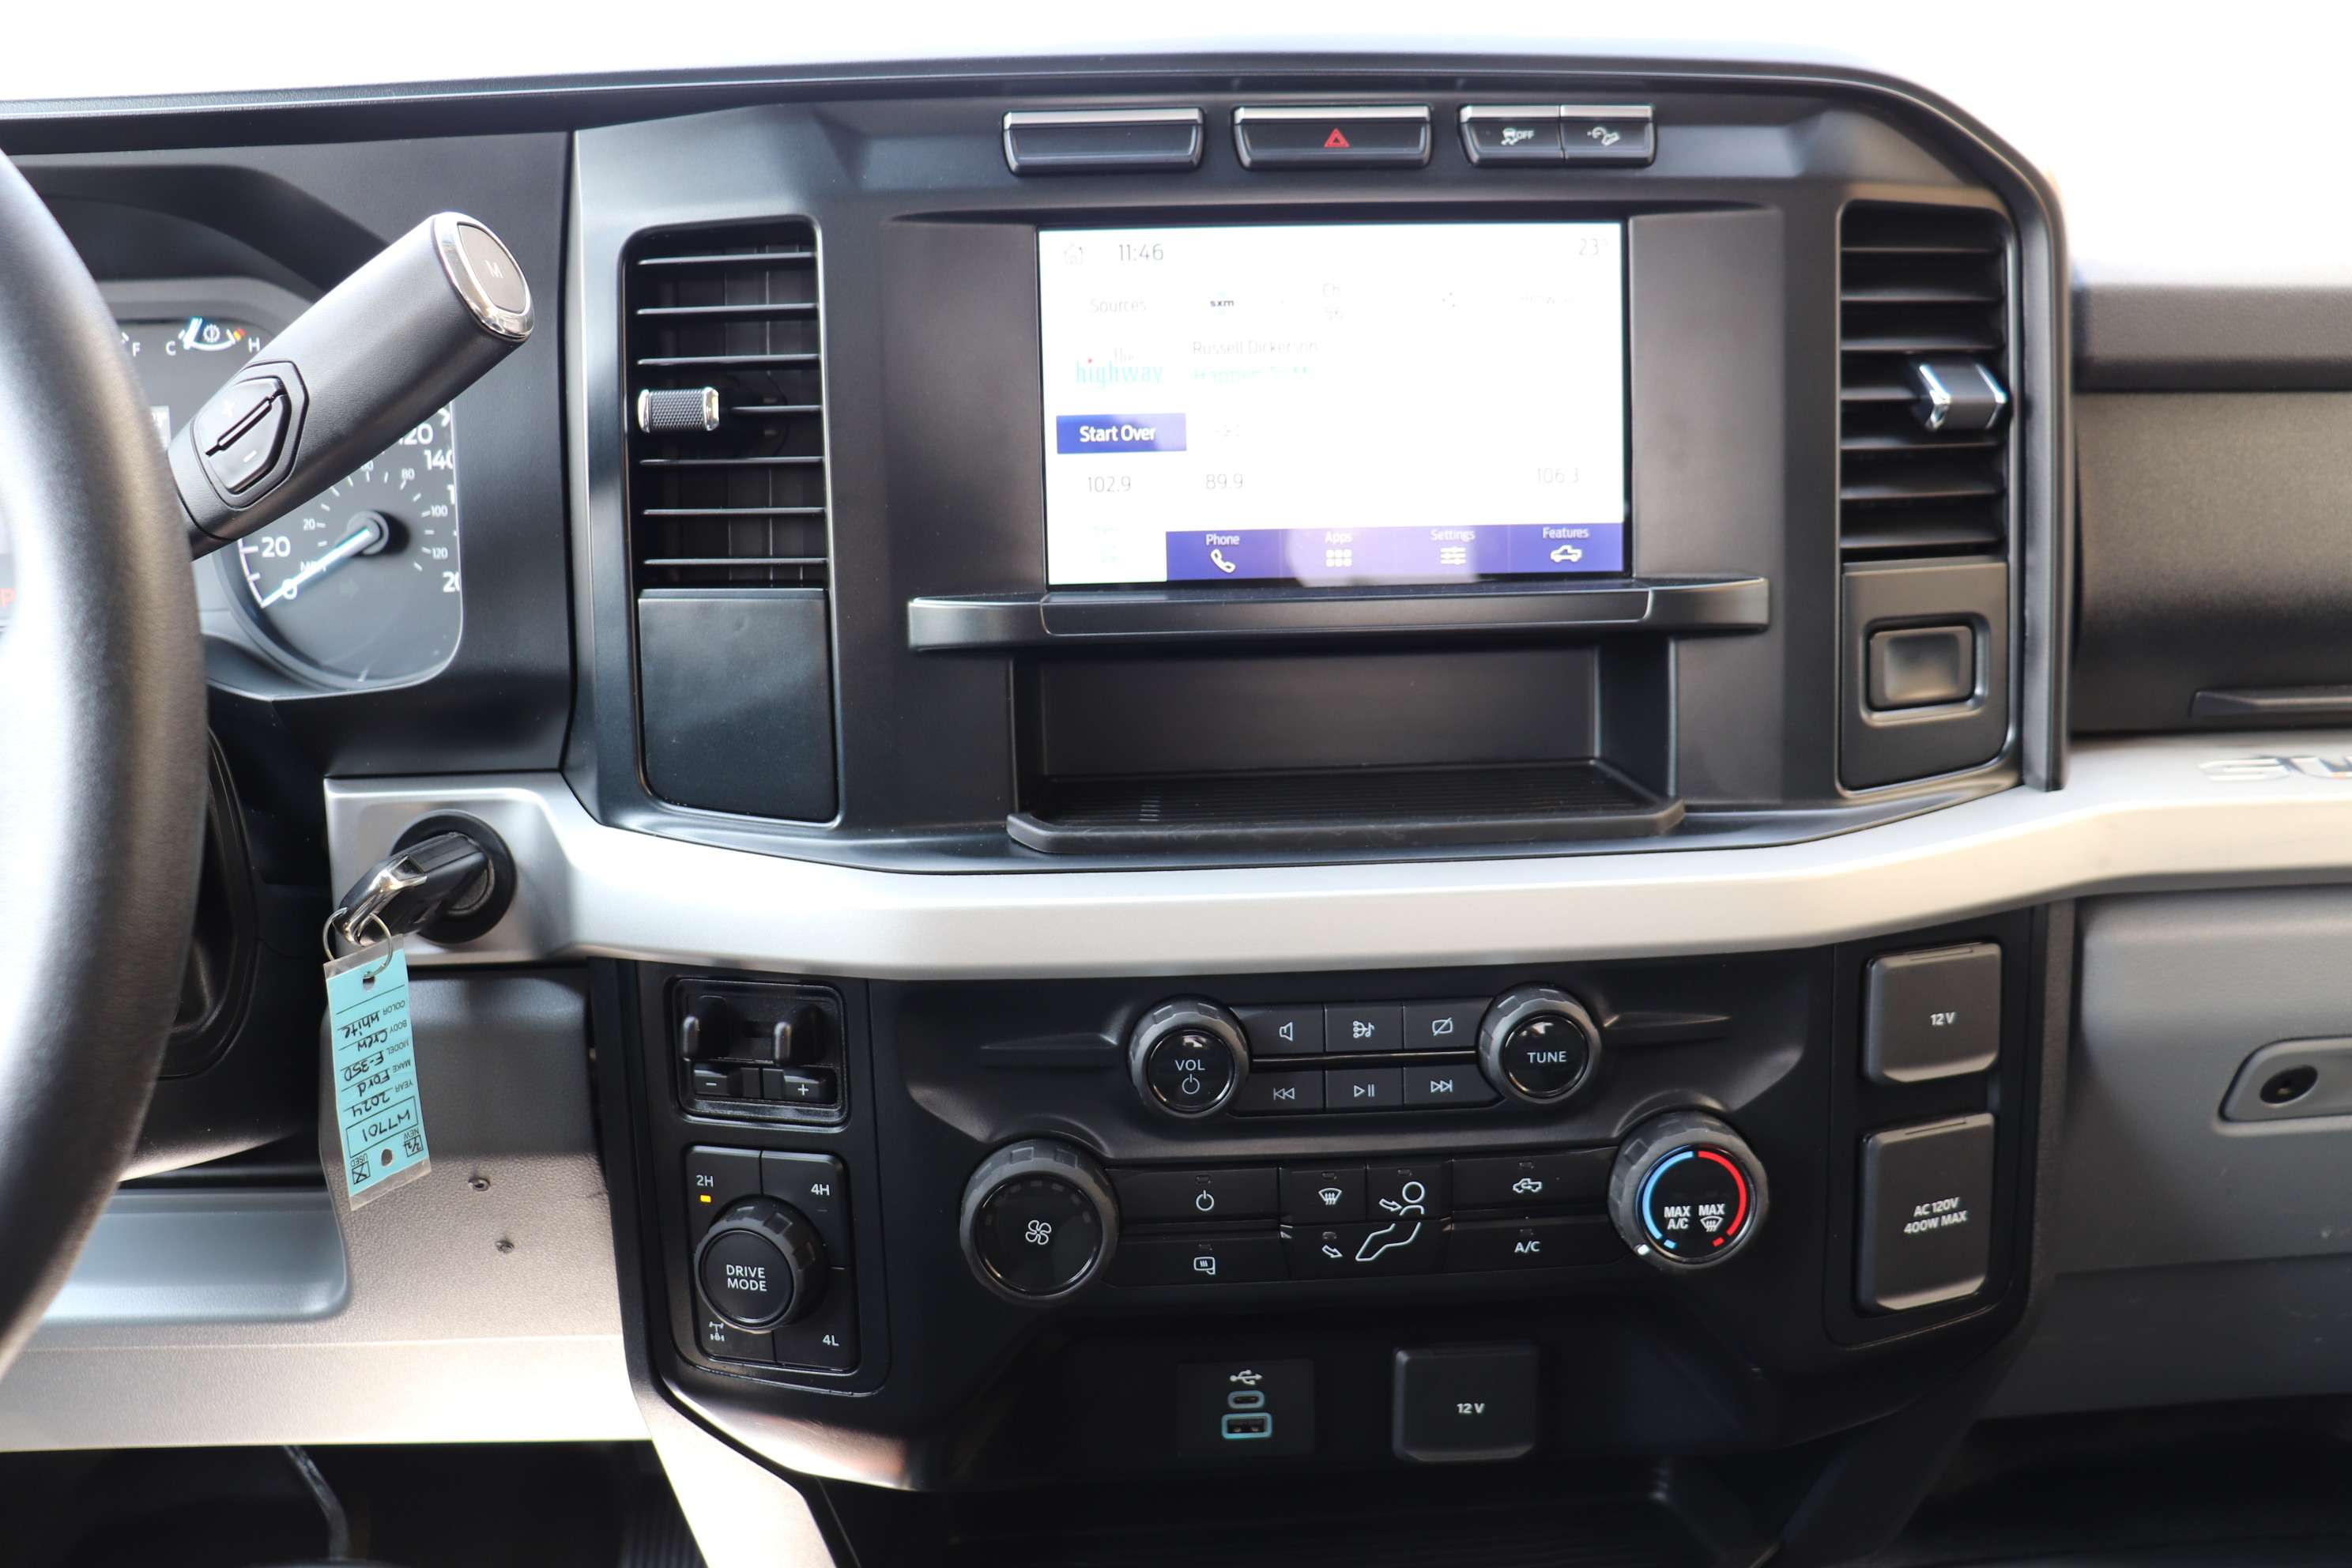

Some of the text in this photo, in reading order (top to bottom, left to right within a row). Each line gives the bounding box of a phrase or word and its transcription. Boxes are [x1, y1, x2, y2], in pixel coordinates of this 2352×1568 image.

[1118, 242, 1164, 262] 11:46
[1088, 298, 1147, 314] Sources
[1209, 299, 1234, 308] sxm
[132, 341, 141, 357] F
[166, 341, 176, 356] C
[248, 337, 261, 352] H
[1075, 360, 1163, 389] highway
[398, 423, 433, 445] 20
[1080, 425, 1155, 442] Start Over
[1087, 475, 1132, 493] 102.9
[1205, 473, 1244, 490] 89.9
[430, 506, 448, 517] 100
[303, 518, 315, 530] 20
[1205, 533, 1240, 546] Phone
[1325, 531, 1352, 545] Apps
[1430, 529, 1476, 543] Settings
[1543, 526, 1589, 540] Features
[262, 536, 291, 557] 20
[432, 548, 448, 559] 120
[382, 1000, 405, 1016] COLOR
[390, 1019, 407, 1035] BODY
[387, 1039, 409, 1056] MODEL
[1527, 1050, 1567, 1064] TUNE
[1174, 1059, 1205, 1072] VOL
[357, 1059, 411, 1097] MAKE Ford
[352, 1080, 413, 1118] YEAR 2024
[403, 1128, 420, 1140] NEW
[350, 1153, 368, 1167] USED
[695, 1175, 714, 1187] 2H
[811, 1184, 830, 1196] 4H
[1664, 1205, 1690, 1219] MAX
[1698, 1204, 1725, 1217] MAX
[1913, 1197, 1960, 1218] AC 120V
[1668, 1217, 1689, 1231] A/C
[1904, 1209, 1967, 1234] 400W MAX
[1514, 1239, 1540, 1255] A/C
[726, 1265, 766, 1279] DRIVE
[727, 1278, 767, 1292] MODE
[823, 1335, 839, 1347] 4L
